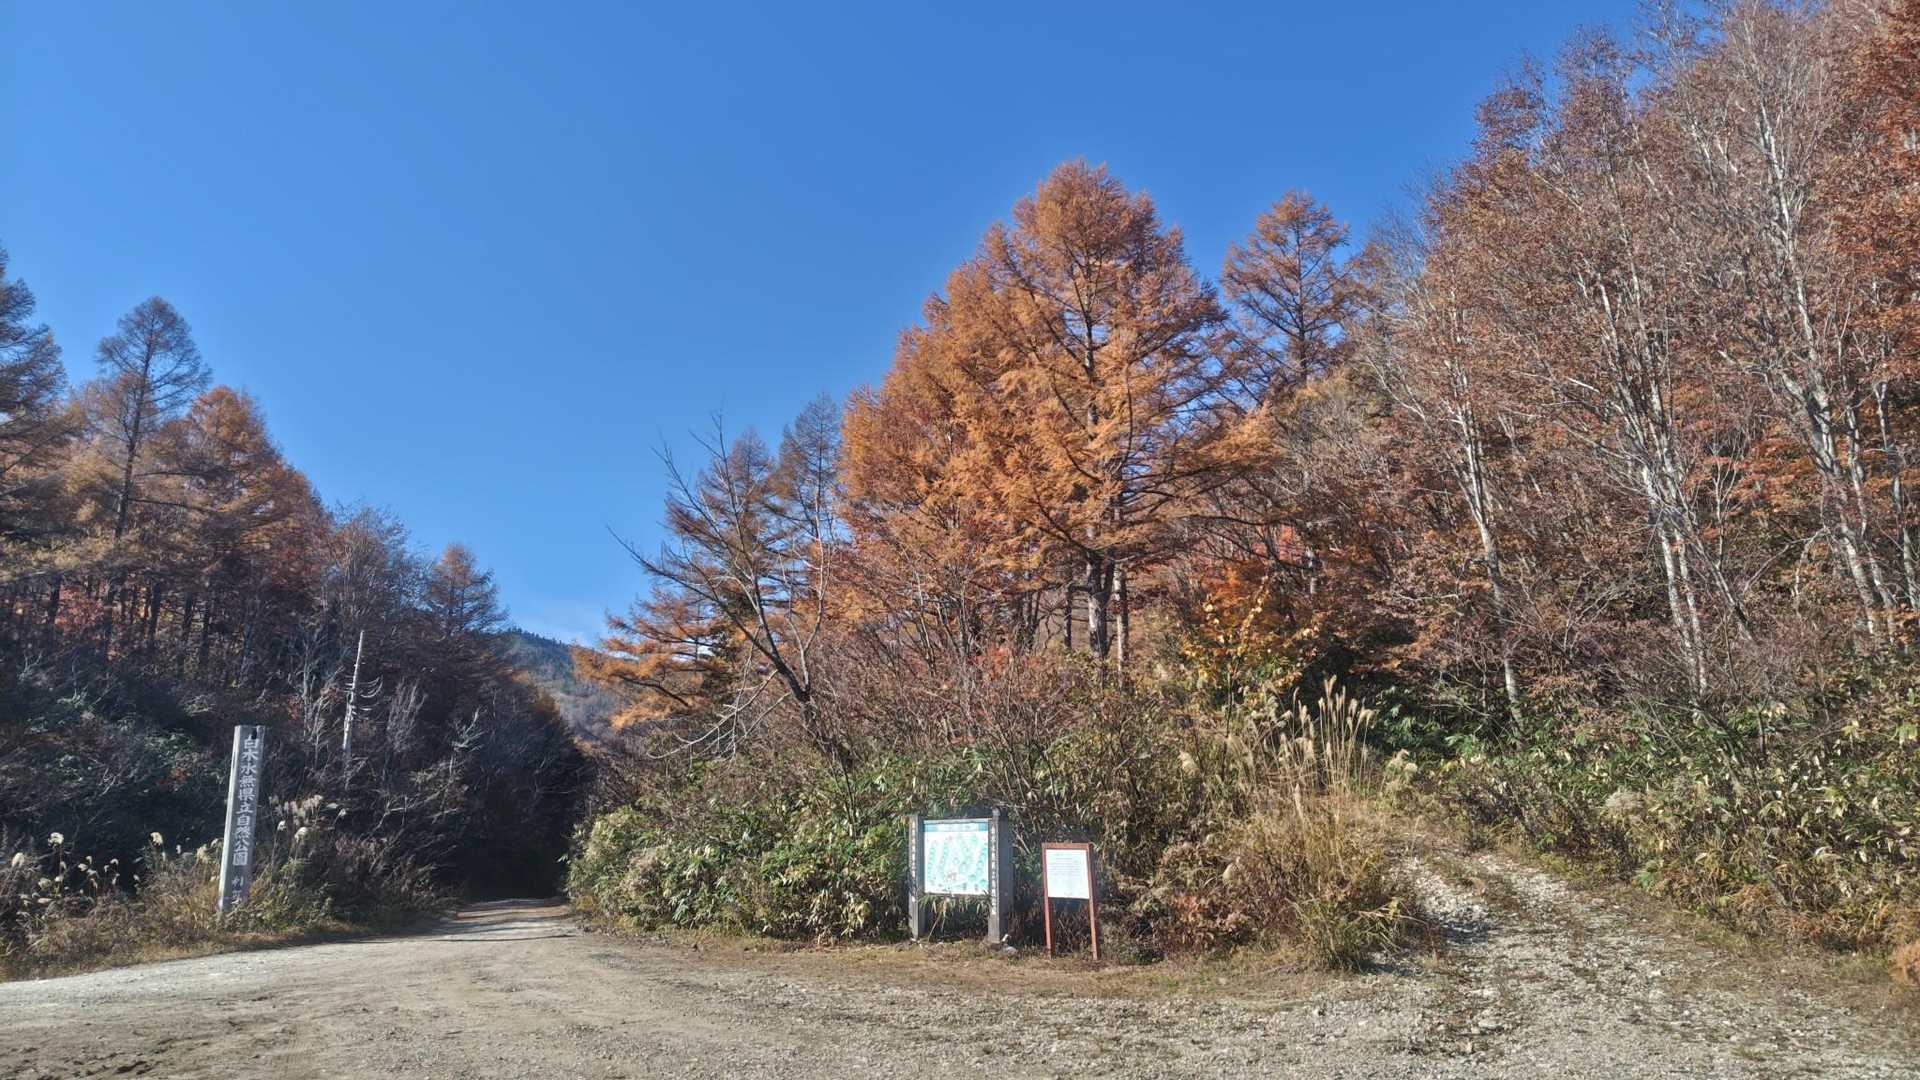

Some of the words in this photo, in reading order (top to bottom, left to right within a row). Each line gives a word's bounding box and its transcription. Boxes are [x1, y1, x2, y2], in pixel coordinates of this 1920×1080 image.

[232, 734, 259, 866] 白木水無県立自然公園
